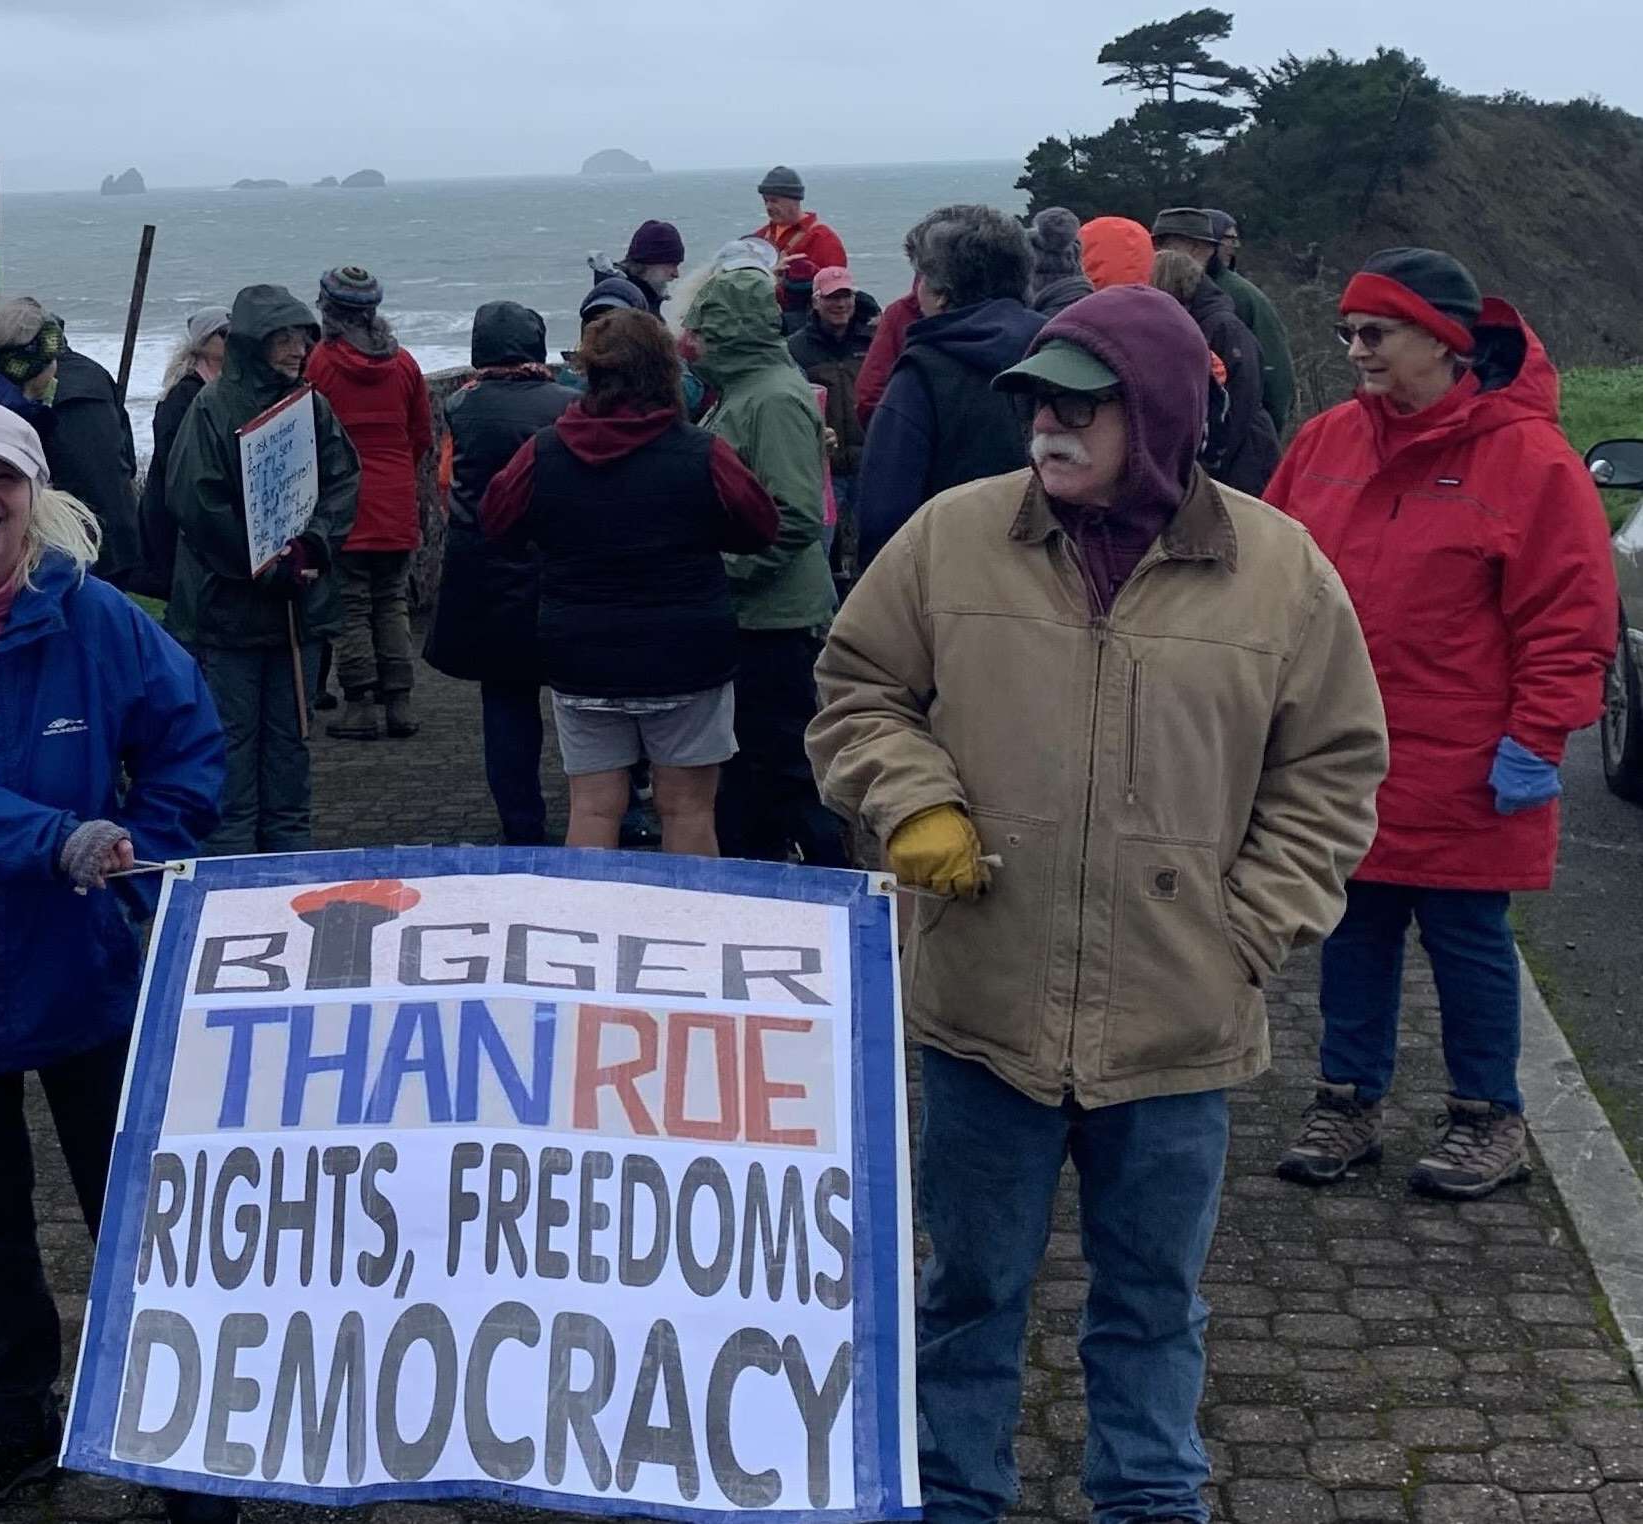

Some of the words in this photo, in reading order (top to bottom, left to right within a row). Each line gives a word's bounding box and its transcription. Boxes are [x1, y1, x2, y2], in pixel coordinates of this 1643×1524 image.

[279, 439, 294, 458] sex
[194, 884, 831, 1006] BIGGER
[204, 1000, 556, 1128] THAN
[572, 1008, 817, 1147] ROE
[136, 1141, 415, 1300] RIGHTS,
[446, 1141, 853, 1311] FREEDOMS
[112, 1300, 853, 1511] DEMOCRACY
